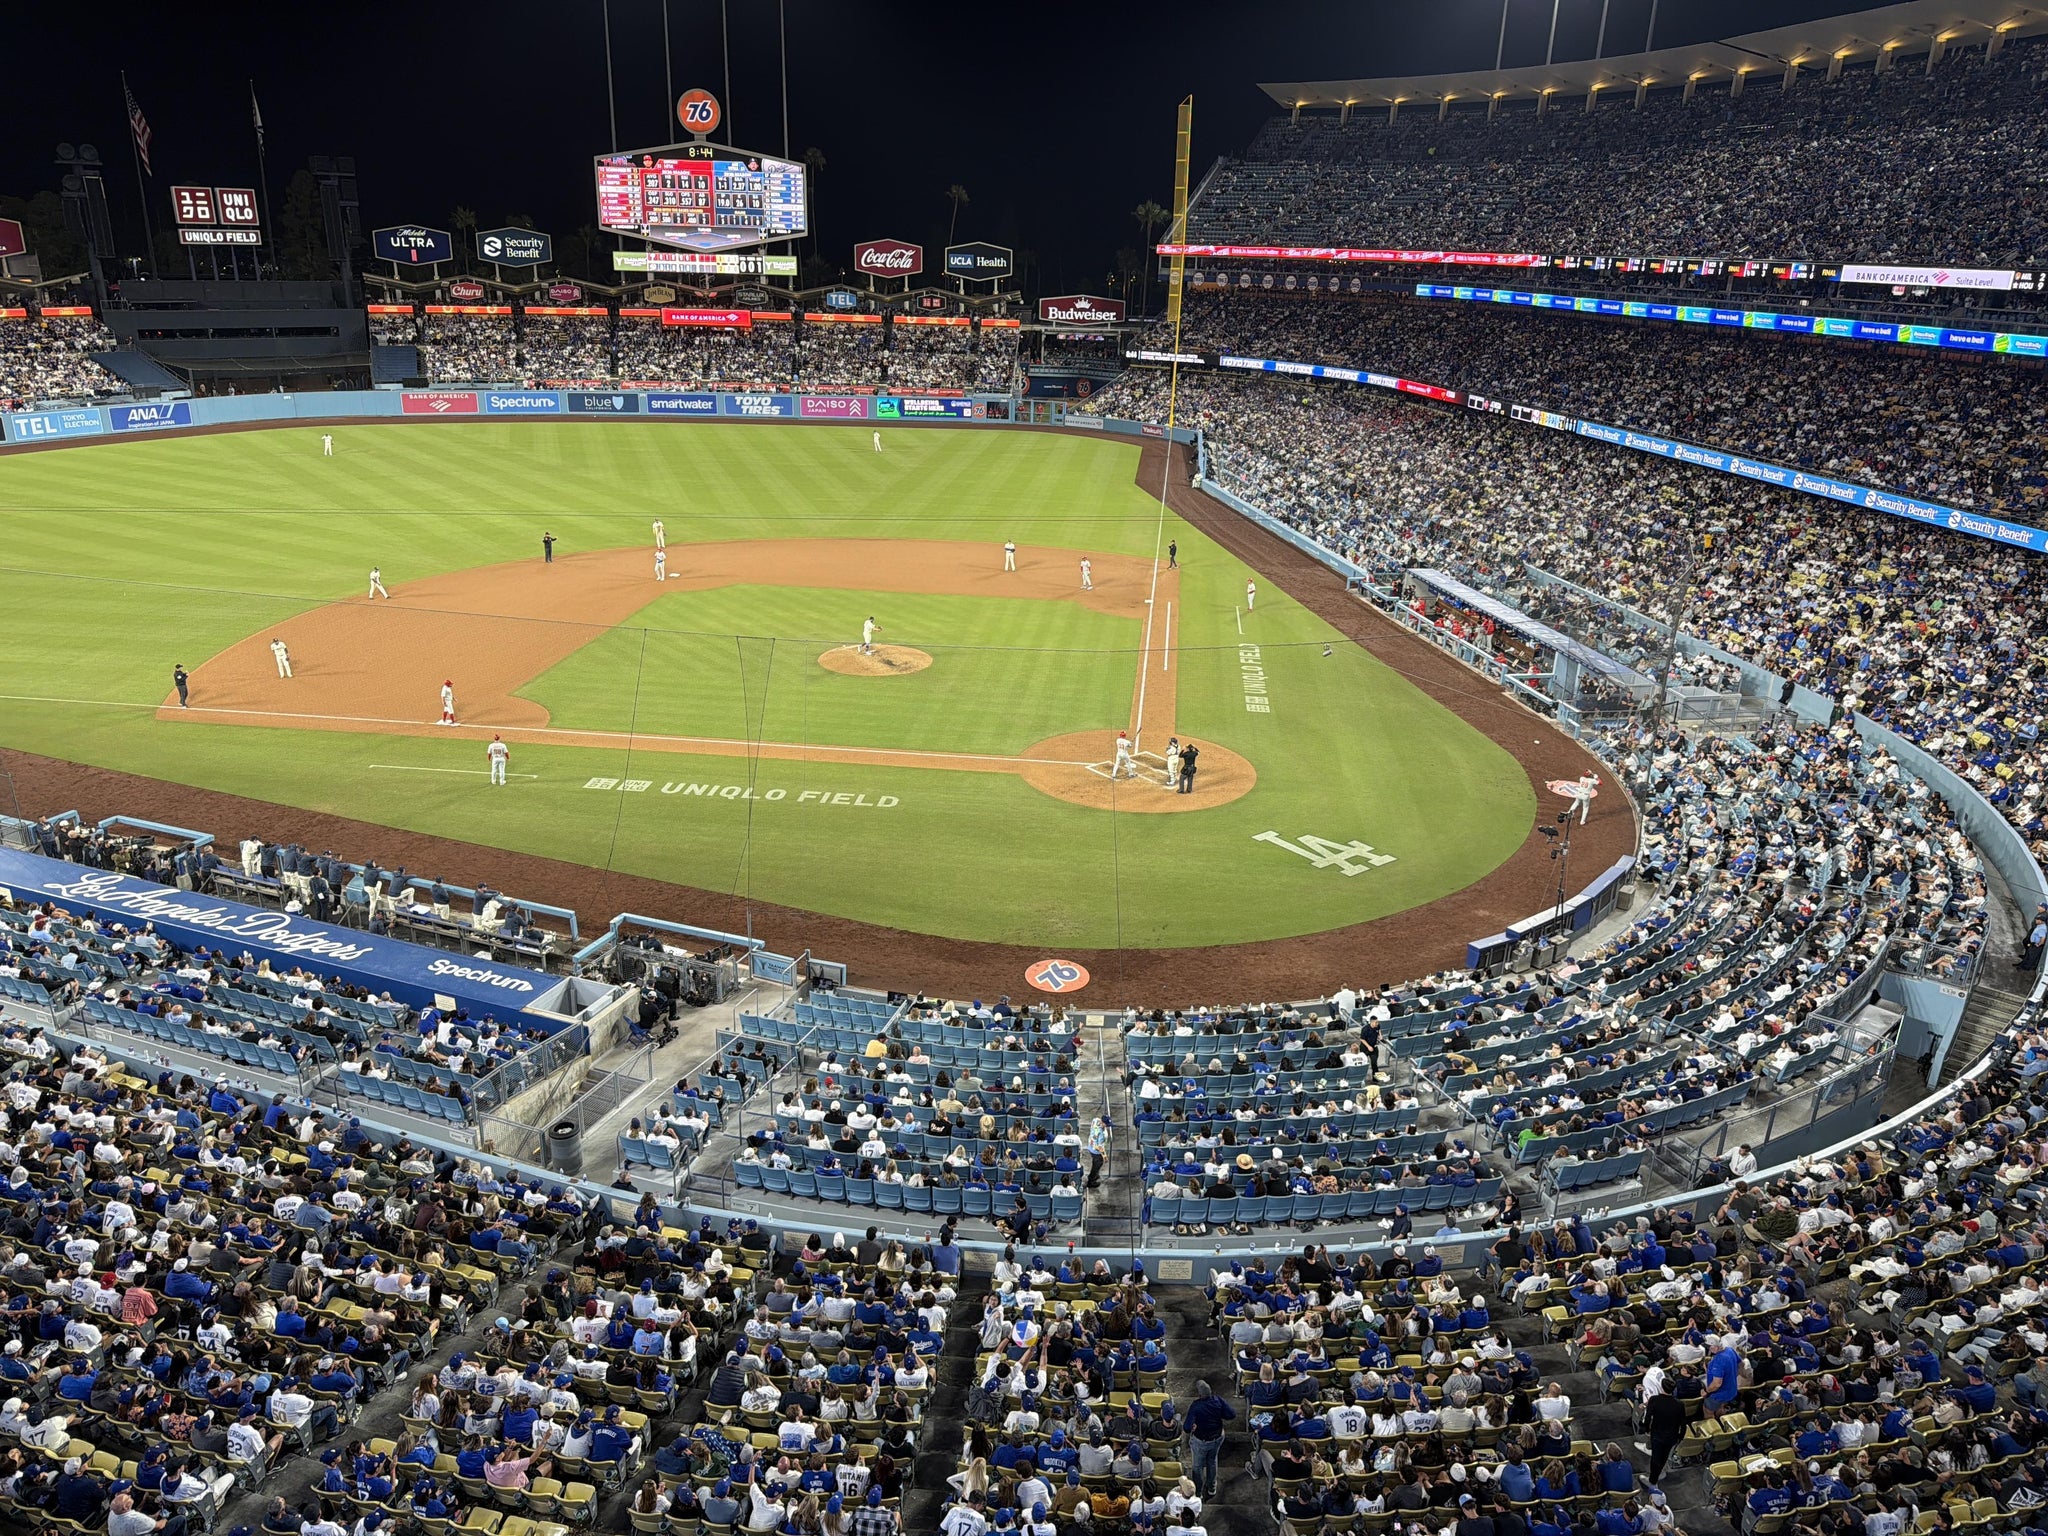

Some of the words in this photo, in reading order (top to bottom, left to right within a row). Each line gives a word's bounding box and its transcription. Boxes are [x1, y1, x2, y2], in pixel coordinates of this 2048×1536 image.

[685, 99, 714, 123] 76
[688, 147, 713, 158] 8:44
[223, 193, 249, 206] UNI
[226, 207, 253, 222] QLO
[184, 232, 224, 243] UNIQLO
[226, 232, 256, 242] FIELD
[390, 237, 435, 248] ULTRA
[505, 237, 544, 250] Security
[506, 248, 540, 258] Benefit
[860, 248, 916, 269] Coca-Cola
[950, 257, 972, 266] UCLA
[976, 256, 1007, 267] Health
[1856, 272, 1878, 281] BANK
[1880, 274, 1890, 282] OF
[1892, 274, 1929, 283] AMERICA
[1956, 277, 1973, 286] Suite
[1975, 278, 1993, 286] Level
[2040, 273, 2046, 281] 2
[452, 286, 482, 296] Churu
[830, 294, 854, 306] TEL
[1079, 382, 1089, 392] 76
[491, 396, 551, 409] Spectrum
[584, 396, 612, 407] blue
[651, 399, 712, 410] smartwater
[735, 396, 772, 406] TOYO
[807, 400, 846, 409] DAISO
[128, 408, 159, 422] ANA
[742, 406, 780, 415] TIRES
[14, 416, 58, 436] TEL
[64, 419, 100, 429] ELECTRON
[1587, 426, 1604, 438] Security
[1604, 430, 1619, 441] Benefit
[1632, 437, 1650, 449] Security
[1651, 442, 1668, 452] Benefit
[1682, 450, 1702, 462] Security
[1704, 455, 1722, 466] Benefit
[1739, 462, 1762, 478] Security
[1763, 468, 1784, 482] Benefit
[1804, 478, 1830, 494] Security
[1830, 484, 1854, 499] Benefit
[1876, 497, 1907, 516] Security
[1908, 504, 1935, 520] Benefit
[1961, 516, 1998, 538] Security
[1998, 524, 2030, 543] Benefit
[1238, 644, 1262, 664] FIELD
[1241, 666, 1269, 694] UNIQLO
[660, 782, 787, 800] UNIQLO
[796, 790, 899, 808] FIELD
[1250, 830, 1398, 877] LA
[43, 872, 116, 903] Los
[108, 887, 236, 930] Angeles
[216, 912, 373, 960] Dodgers
[427, 958, 529, 992] Spectrum
[1035, 962, 1080, 990] 76
[421, 1010, 431, 1020] 17
[480, 1046, 488, 1054] 17
[862, 1150, 873, 1158] 17
[280, 1209, 295, 1220] 22
[72, 1253, 80, 1263] 5
[1536, 1280, 1549, 1291] 42
[71, 1288, 84, 1300] 22
[585, 1334, 592, 1343] 3
[642, 1345, 650, 1354] 7
[910, 1340, 933, 1350] Dodgers
[478, 1384, 496, 1395] 42
[272, 1408, 288, 1422] 50
[1346, 1420, 1358, 1432] 18
[28, 1430, 46, 1446] 17
[227, 1440, 242, 1457] 22
[839, 1471, 864, 1482] OHTANI
[842, 1483, 858, 1496] 16
[1806, 1495, 1815, 1506] 8
[958, 1522, 972, 1536] 17
